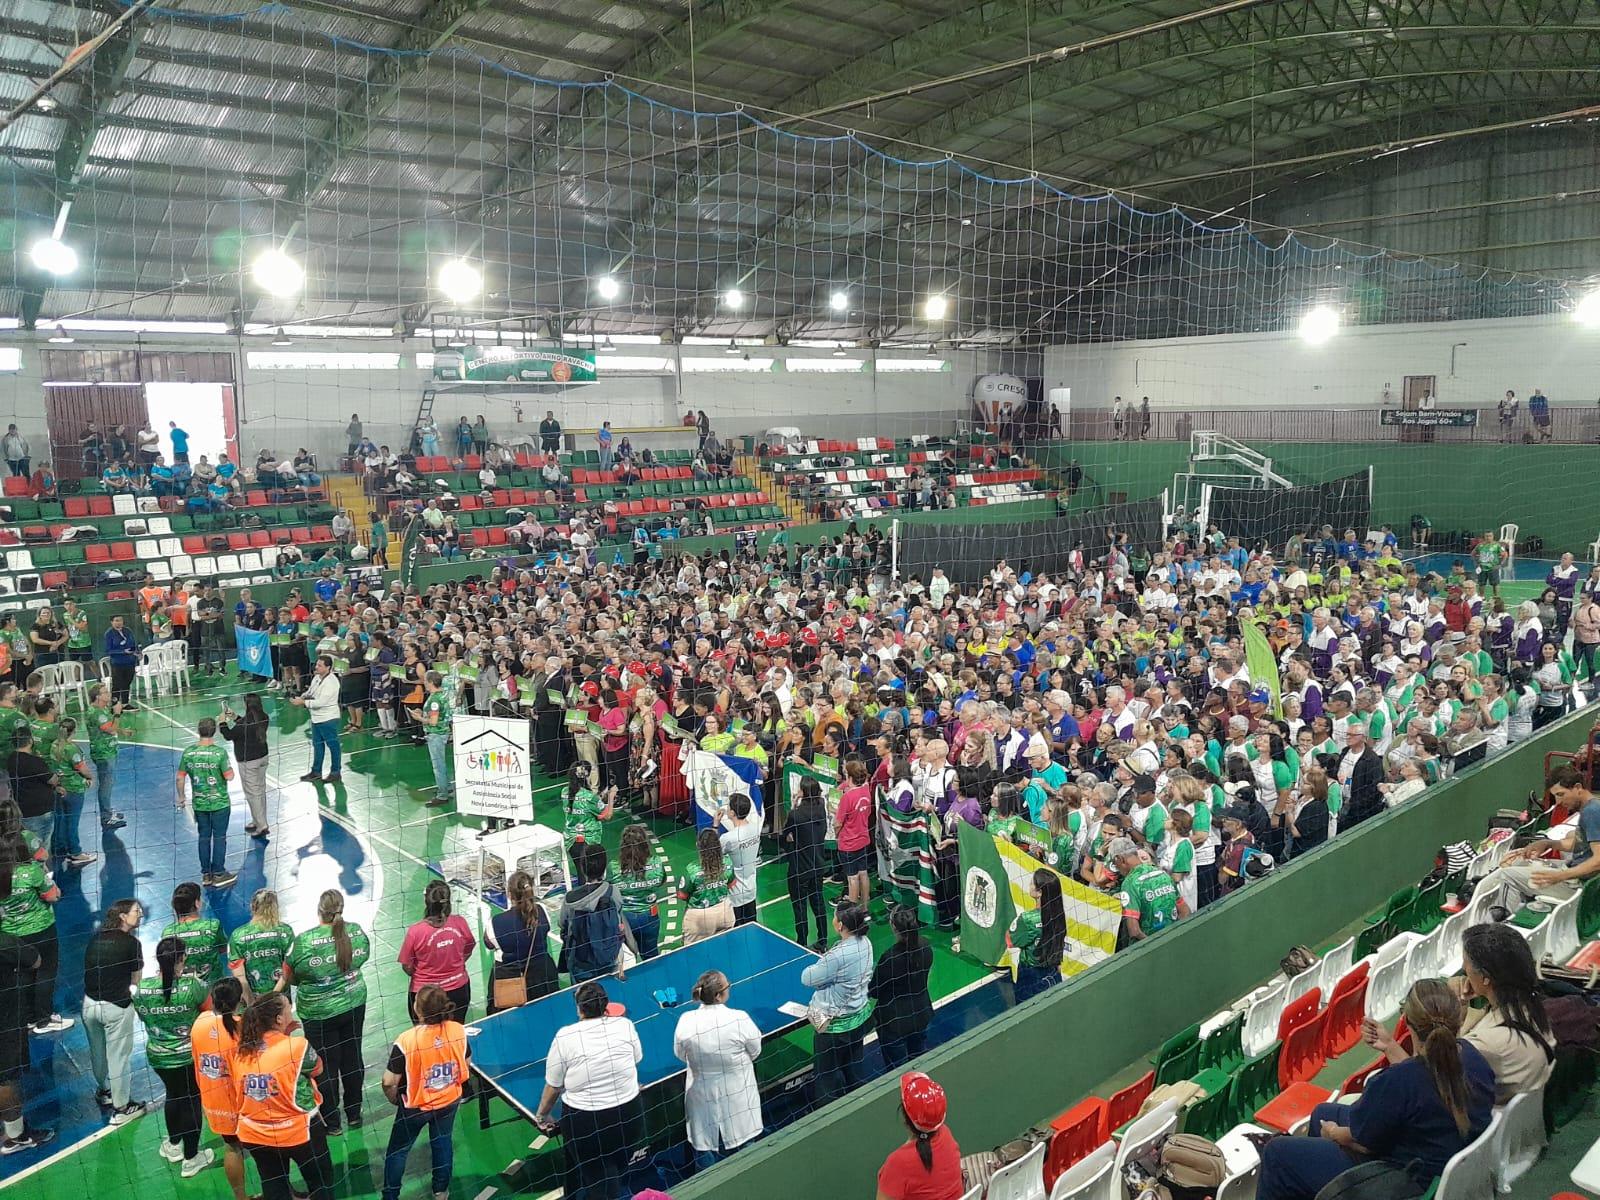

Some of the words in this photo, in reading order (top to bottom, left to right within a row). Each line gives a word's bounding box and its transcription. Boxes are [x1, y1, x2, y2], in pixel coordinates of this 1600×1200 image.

[997, 384, 1025, 395] CRESO
[491, 781, 516, 790] Municipal
[150, 1004, 190, 1015] CRESOL
